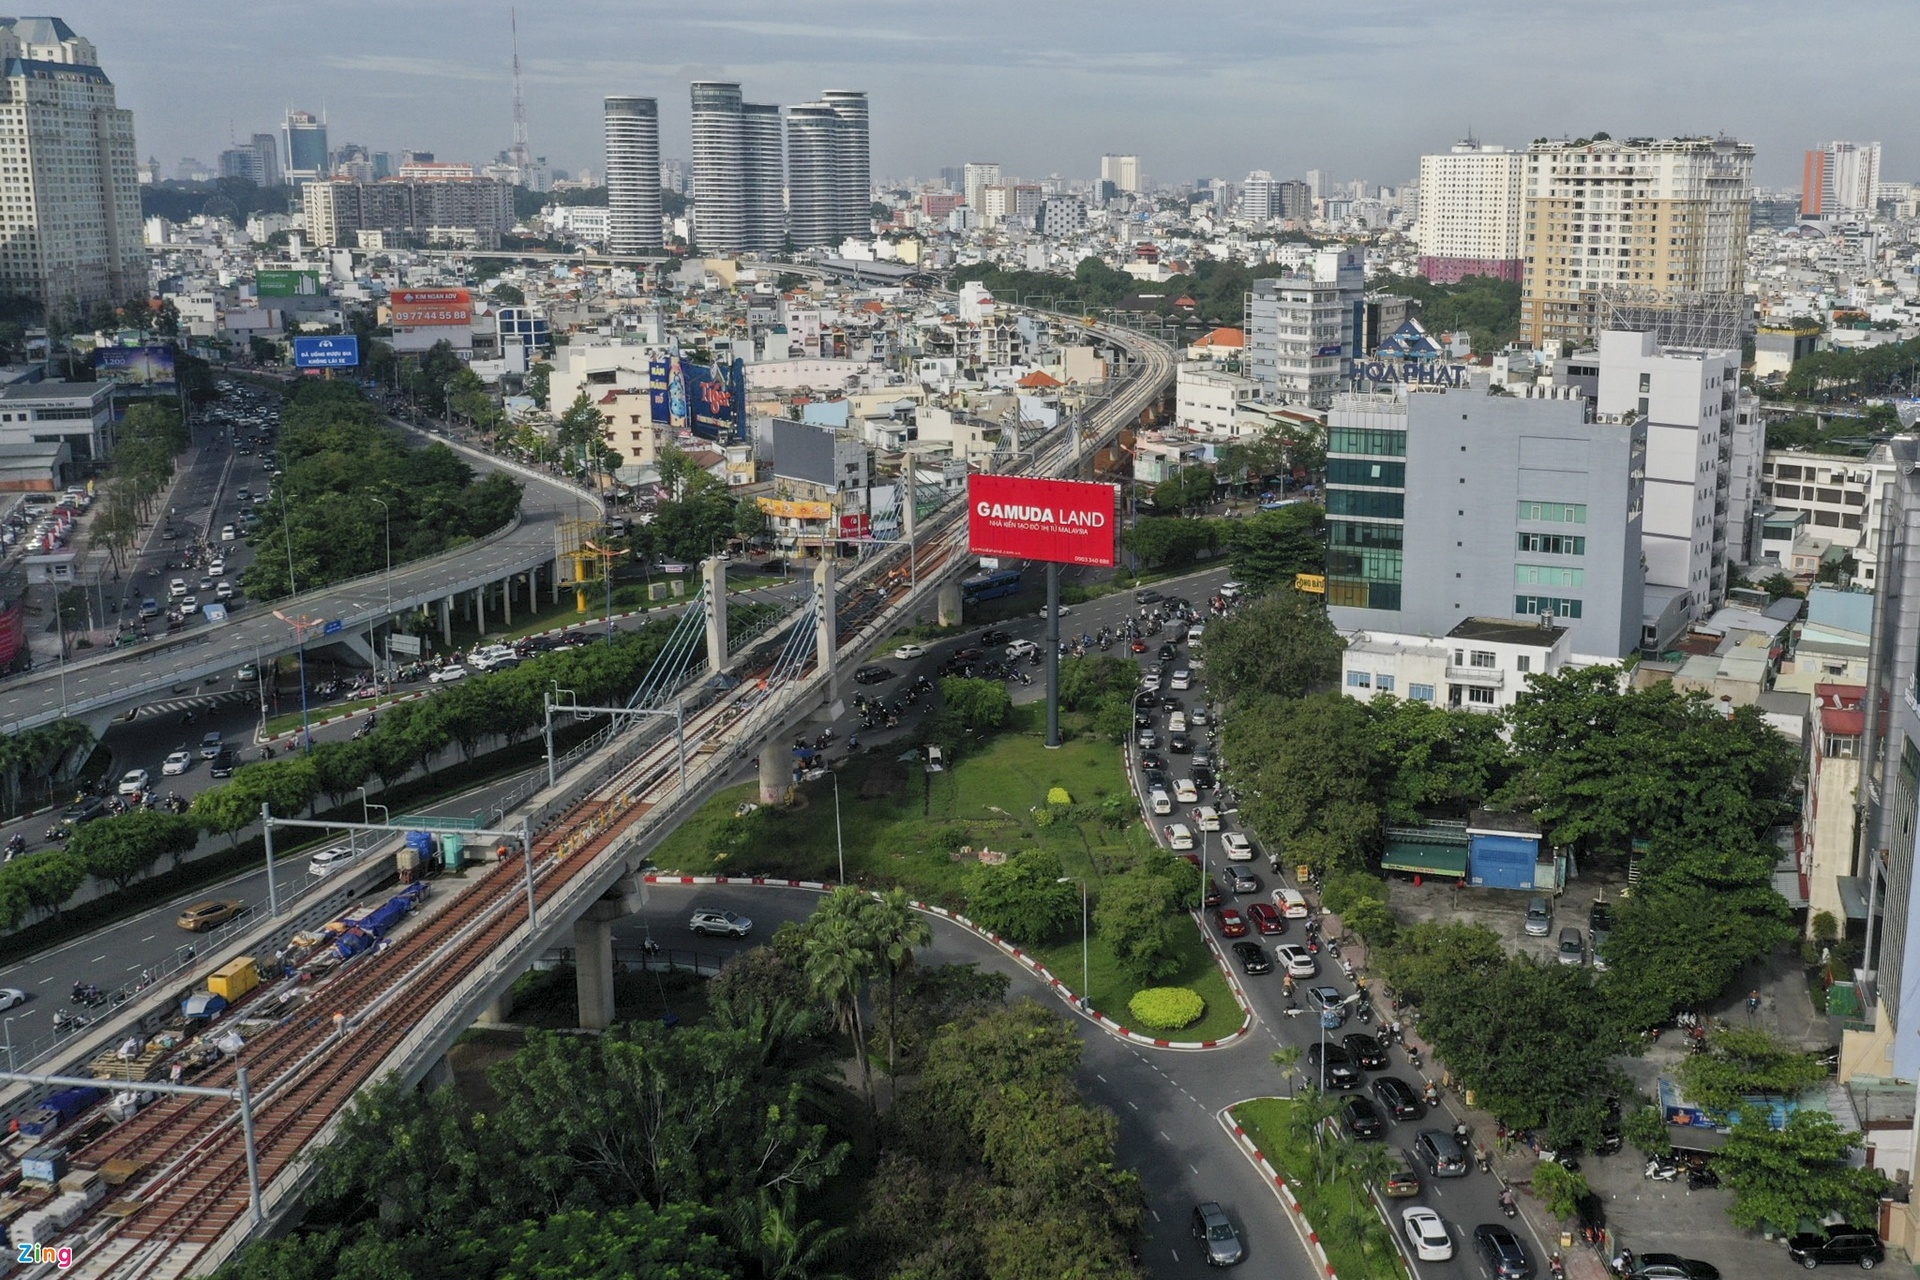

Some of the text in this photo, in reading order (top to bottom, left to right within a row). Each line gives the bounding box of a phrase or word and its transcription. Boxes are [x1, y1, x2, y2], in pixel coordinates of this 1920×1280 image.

[700, 381, 731, 414] Tiger
[977, 502, 1105, 527] GAMUDA LAND
[1058, 526, 1088, 535] MALAYSIA
